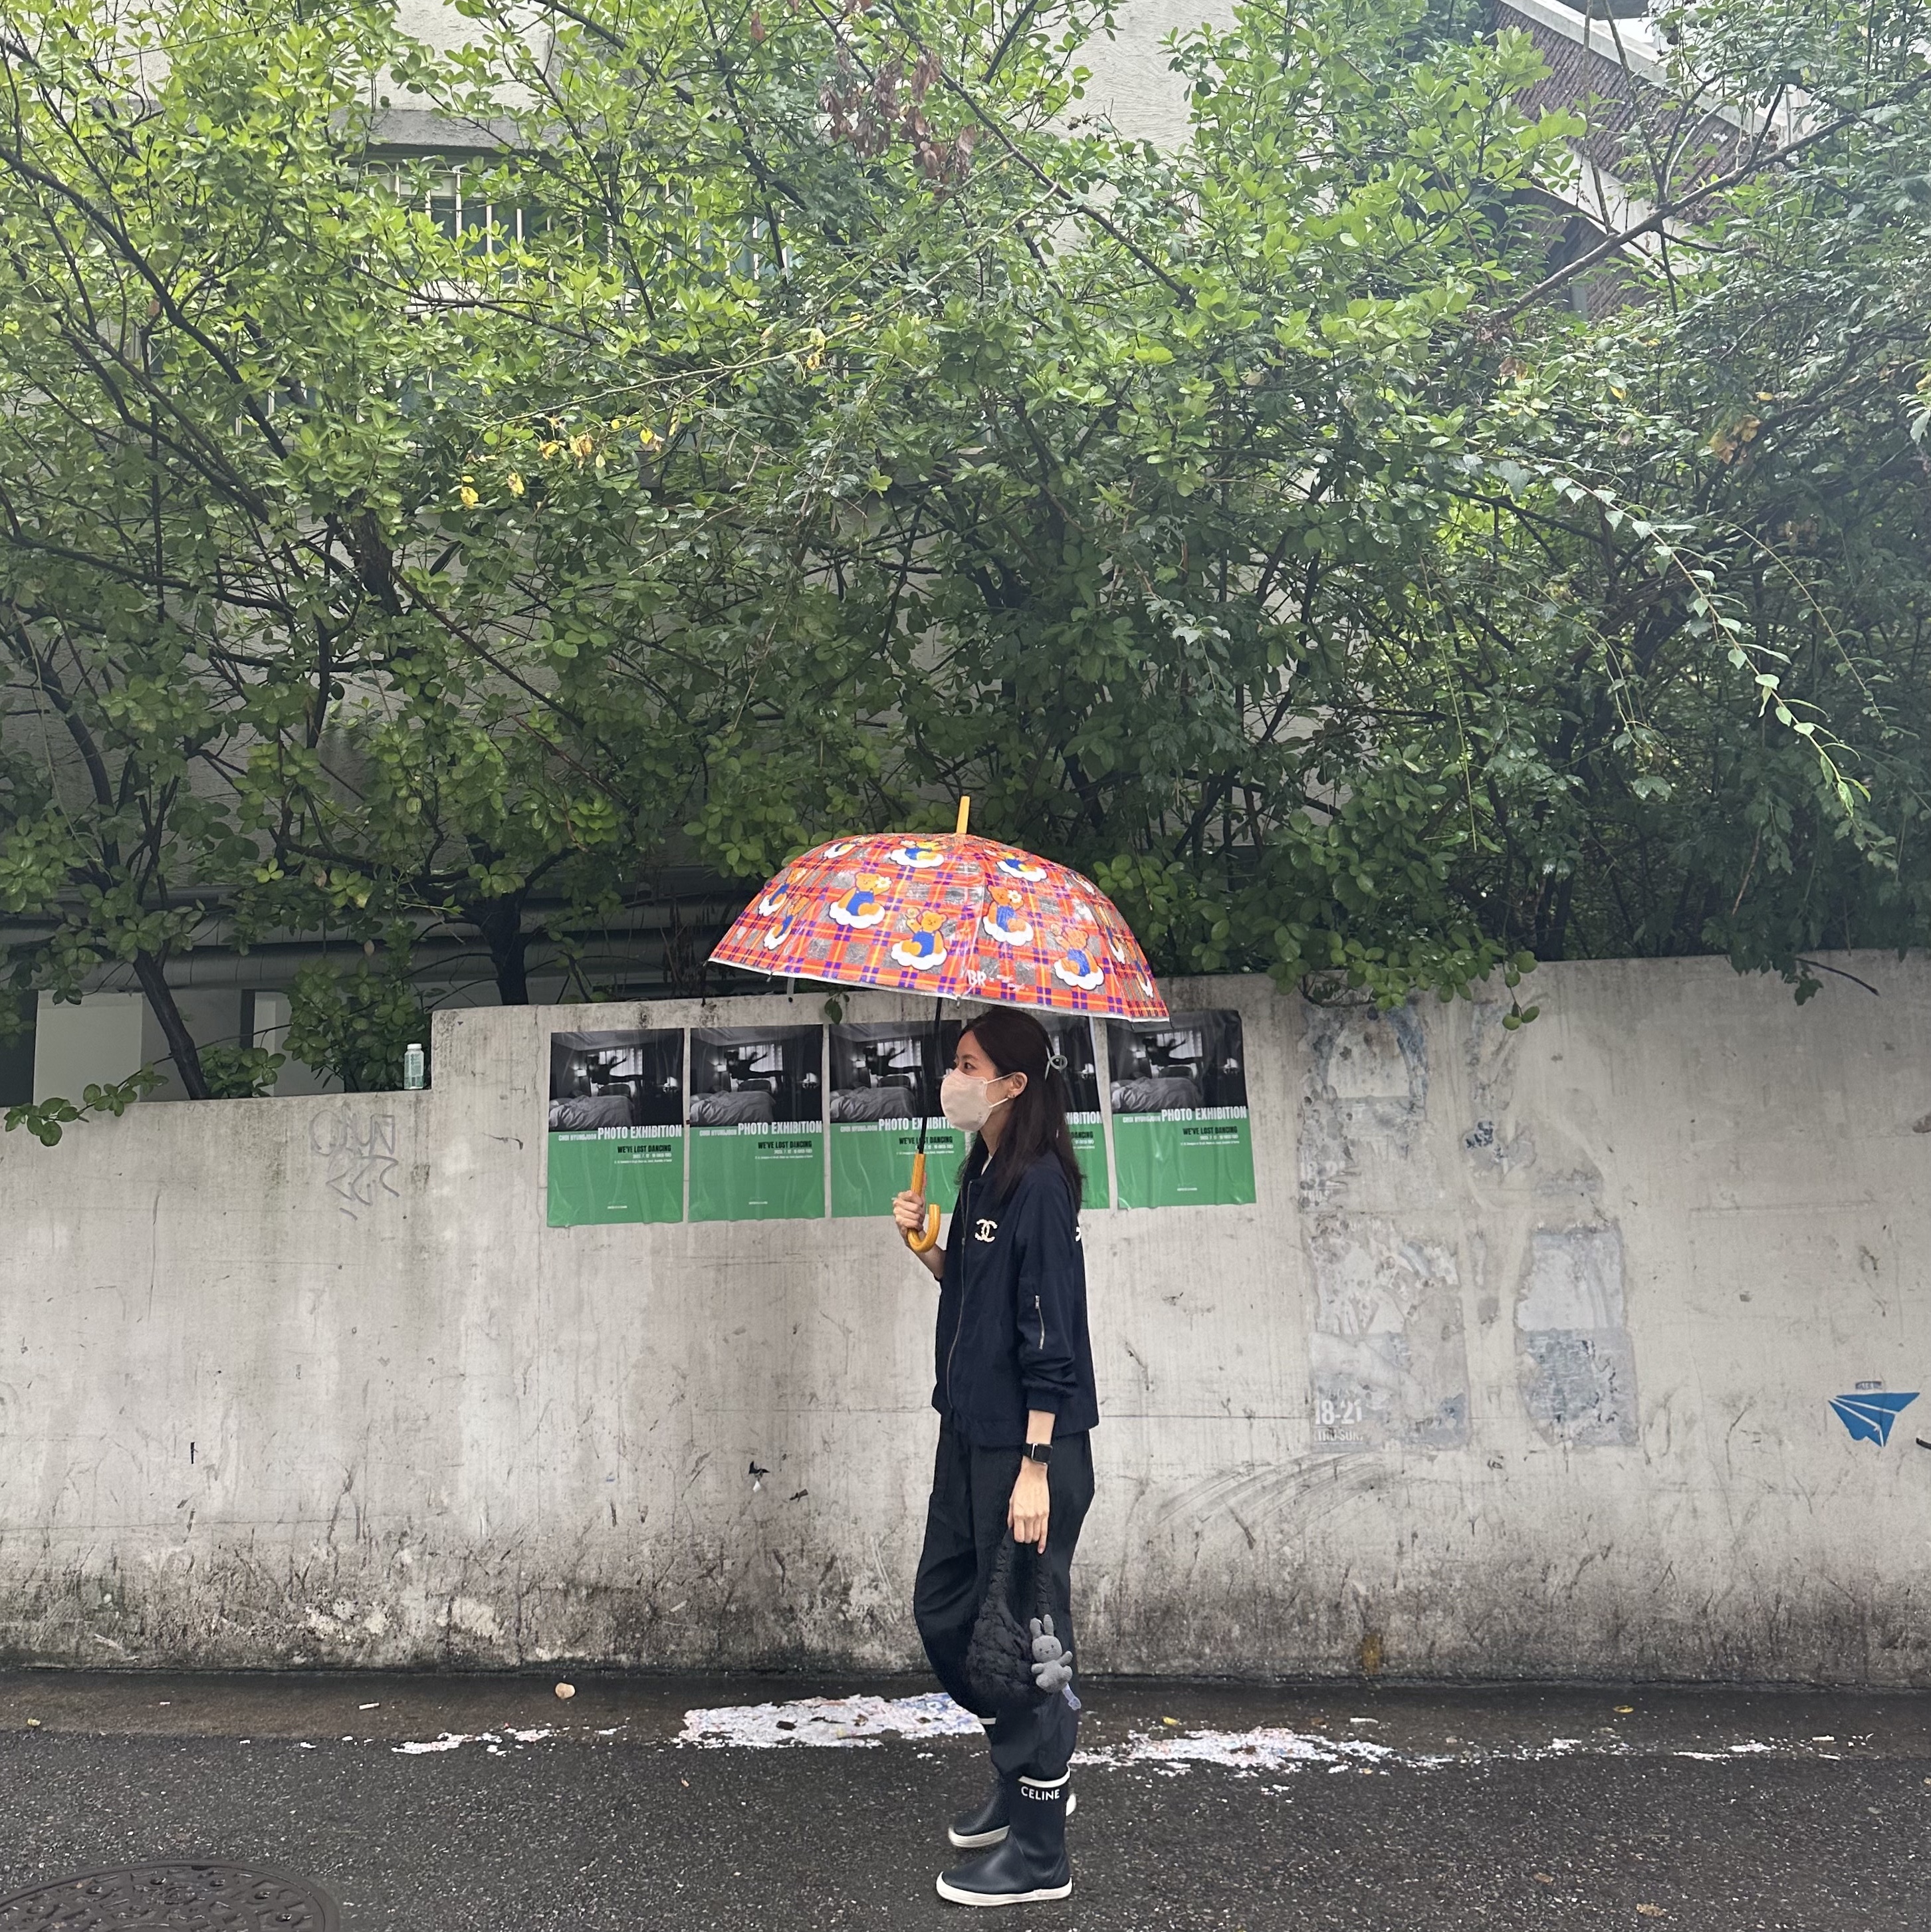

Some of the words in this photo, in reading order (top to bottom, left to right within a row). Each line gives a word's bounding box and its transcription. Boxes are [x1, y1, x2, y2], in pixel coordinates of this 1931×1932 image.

[1161, 1108, 1193, 1122] PHOTO
[1194, 1106, 1247, 1121] EXHIBITION
[598, 1126, 627, 1140] PHOTO
[631, 1124, 682, 1139] EXHIBITION
[738, 1122, 768, 1136] PHOTO
[771, 1121, 822, 1134] EXHIBITION
[878, 1118, 909, 1132] PHOTO
[1314, 1399, 1363, 1425] 18-21
[1021, 1786, 1060, 1800] CELINE
